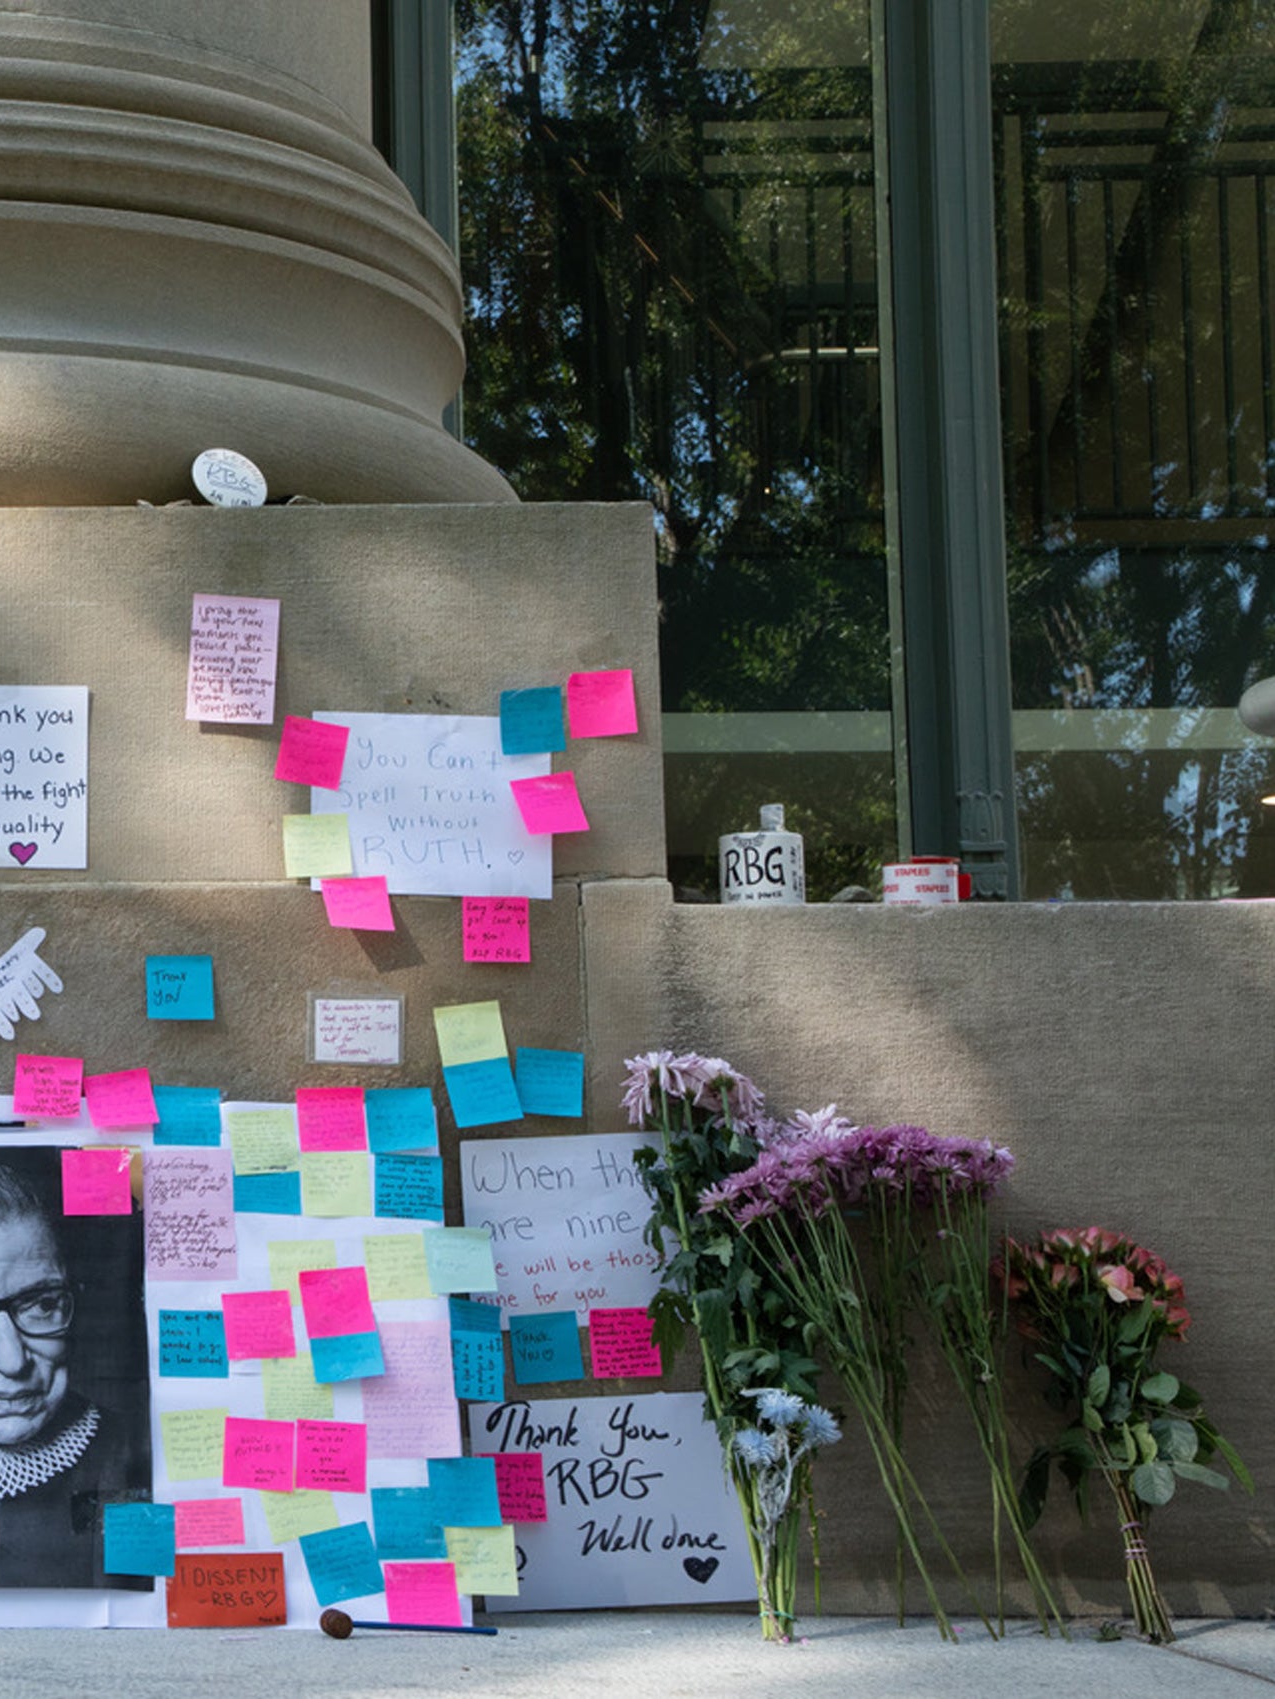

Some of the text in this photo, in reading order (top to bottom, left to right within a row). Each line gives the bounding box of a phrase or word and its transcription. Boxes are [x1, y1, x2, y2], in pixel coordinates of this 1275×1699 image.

[206, 463, 258, 490] RBG
[36, 709, 72, 731] you
[355, 737, 405, 771] You
[427, 740, 502, 770] Can't
[1, 784, 34, 800] the
[42, 778, 86, 808] fight
[337, 780, 395, 808] Spell
[417, 784, 494, 803] Truth
[387, 814, 477, 829] Without
[361, 836, 492, 868] RUTH.
[725, 846, 786, 887] RBG
[894, 867, 930, 877] STAPLES
[915, 884, 950, 893] STAPLES
[495, 947, 521, 960] RBG
[471, 1151, 575, 1194] When
[151, 1211, 177, 1222] Thank
[479, 1210, 641, 1241] are nine
[494, 1262, 510, 1277] e
[524, 1259, 556, 1277] will
[568, 1255, 596, 1273] be
[534, 1284, 557, 1305] for
[176, 1355, 192, 1364] law
[484, 1400, 579, 1452] Thank
[546, 1458, 663, 1506] RBG
[575, 1513, 726, 1556] Well done
[180, 1567, 279, 1588] I DISSENT
